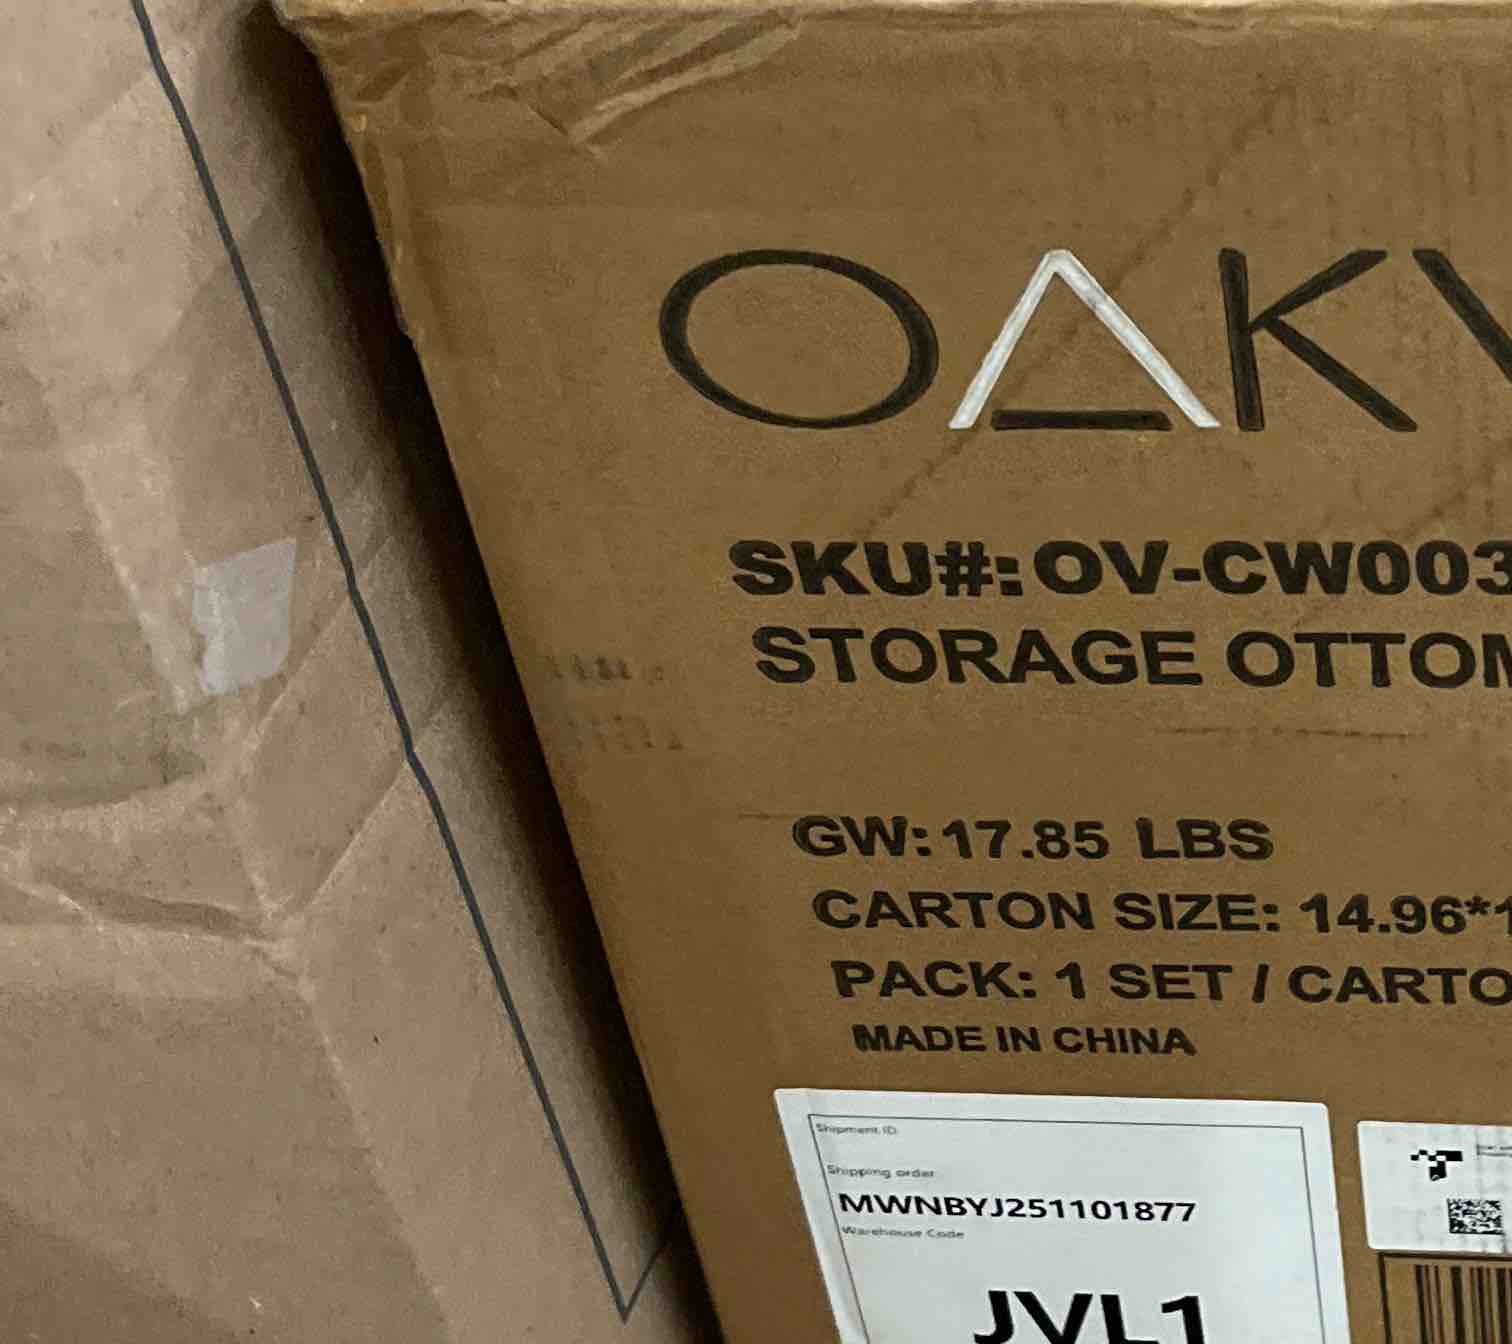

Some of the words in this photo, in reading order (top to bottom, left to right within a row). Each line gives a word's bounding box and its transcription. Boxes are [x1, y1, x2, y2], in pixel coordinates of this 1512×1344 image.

[751, 625, 1204, 686] STORAGE
[1136, 817, 1274, 860] LBS
[811, 889, 1095, 930] CARTON
[1113, 892, 1280, 933] SIZE:
[831, 959, 1038, 999] PACK:
[1055, 961, 1087, 1000] 1
[1108, 963, 1233, 1002] SET
[1251, 963, 1270, 1004] /
[851, 1024, 986, 1053] MADE
[995, 1026, 1041, 1053] IN
[1053, 1026, 1198, 1056] CHINA
[827, 1164, 892, 1180] Shipping
[838, 1193, 1197, 1223] MWNBYJ251101877
[841, 1225, 923, 1239] Warehouse
[926, 1227, 966, 1240] Code
